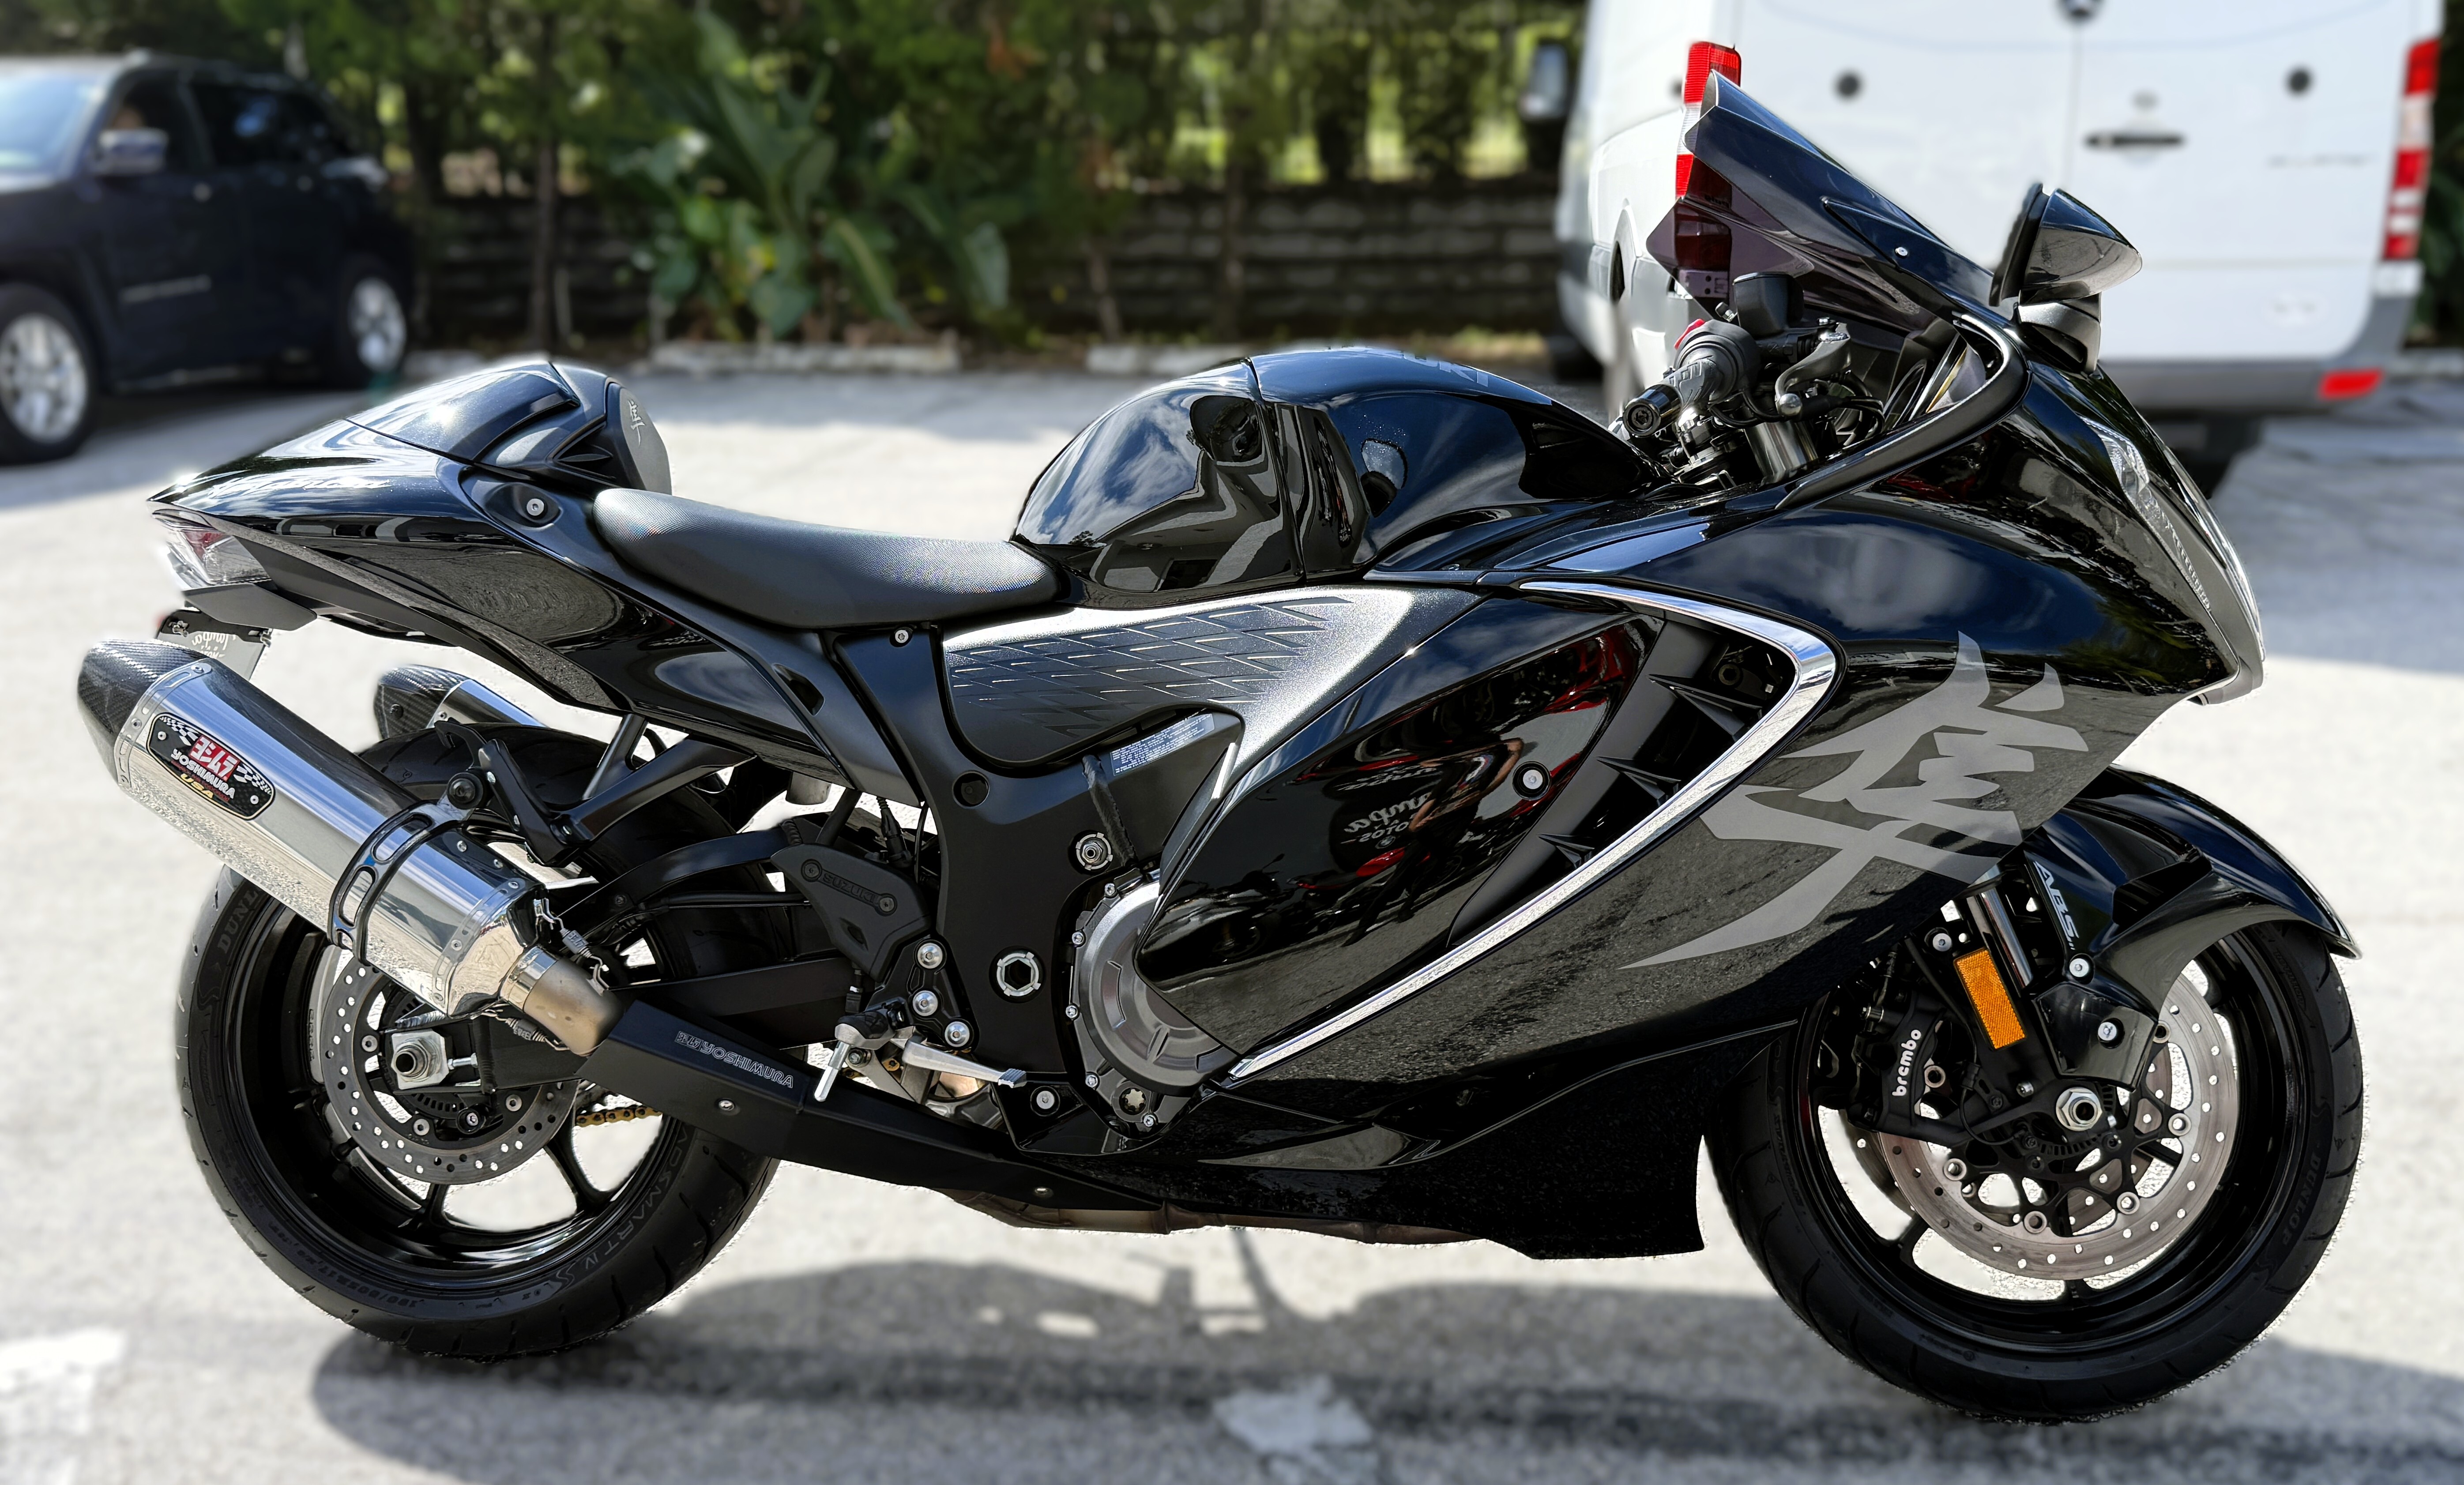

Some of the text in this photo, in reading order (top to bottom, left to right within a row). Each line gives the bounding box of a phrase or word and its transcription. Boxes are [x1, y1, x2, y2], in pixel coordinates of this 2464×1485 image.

[170, 748, 236, 799] YOSHIMURA
[180, 773, 214, 799] USA
[216, 887, 261, 954] DUNL
[822, 872, 877, 904] SUZUKI
[2033, 861, 2080, 943] ABS
[701, 1041, 794, 1089] YOSHIMURA
[1892, 1029, 1922, 1097] brembo
[604, 1125, 687, 1256] ADSMART
[2281, 1151, 2321, 1246] DUNLOP
